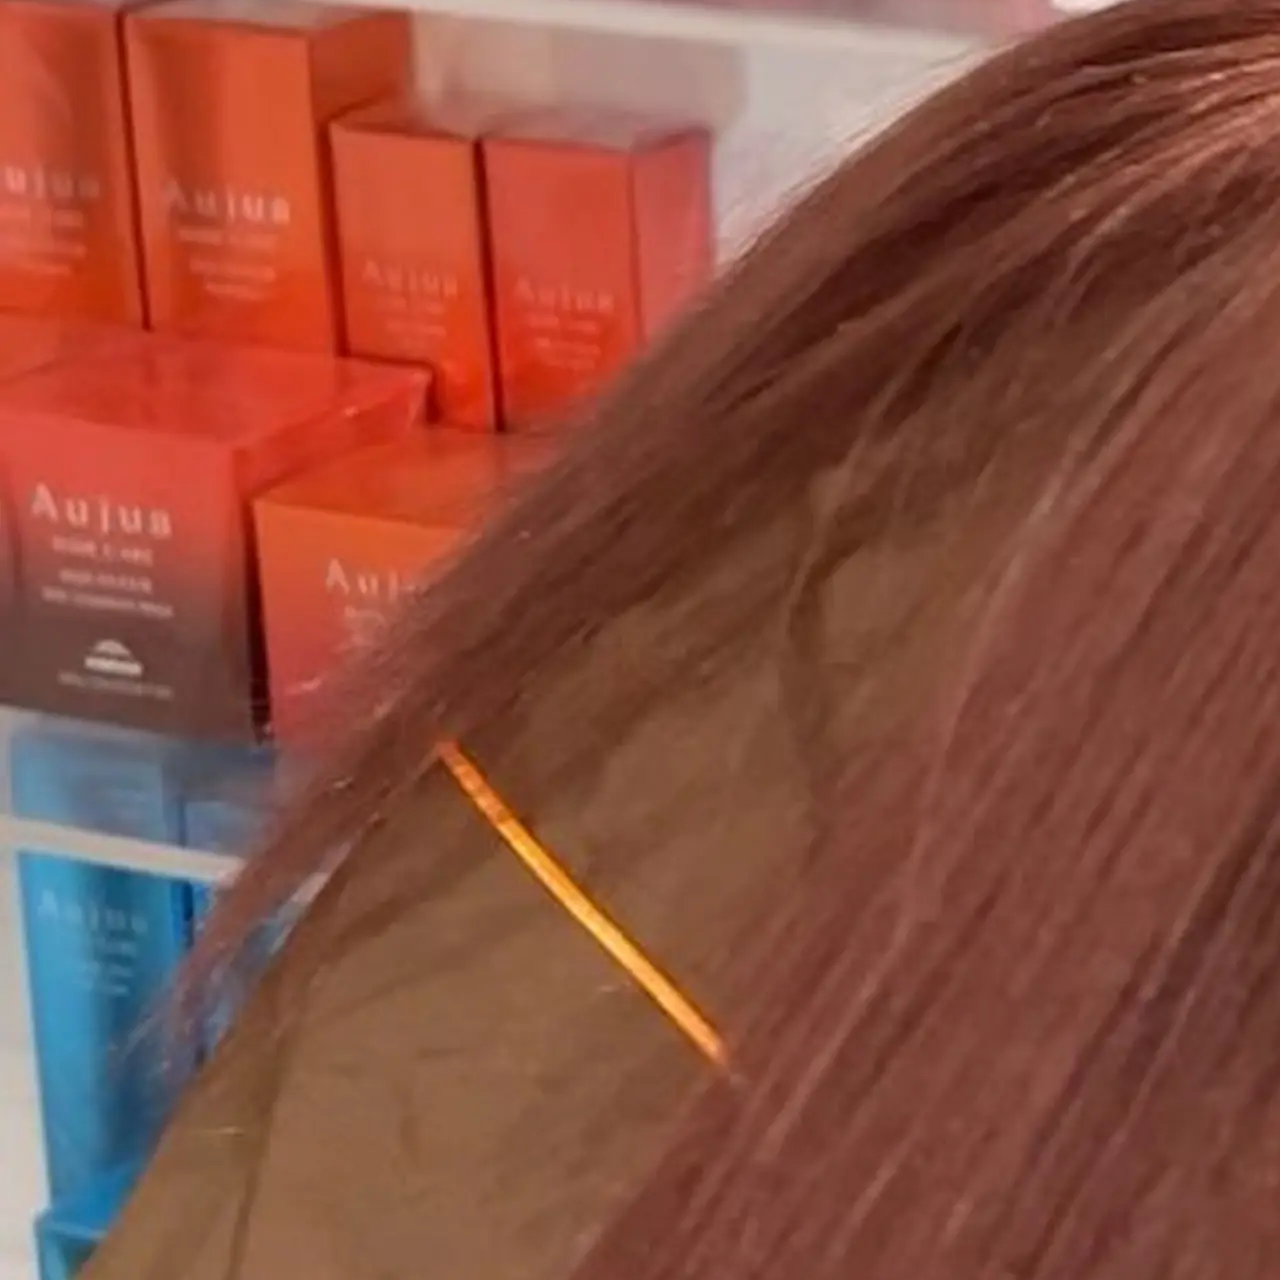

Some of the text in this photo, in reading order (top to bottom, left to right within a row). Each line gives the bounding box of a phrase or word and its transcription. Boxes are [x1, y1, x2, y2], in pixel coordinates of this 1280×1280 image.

[3, 165, 101, 200] ujua
[31, 482, 172, 540] Aujua
[325, 557, 400, 605] Auj
